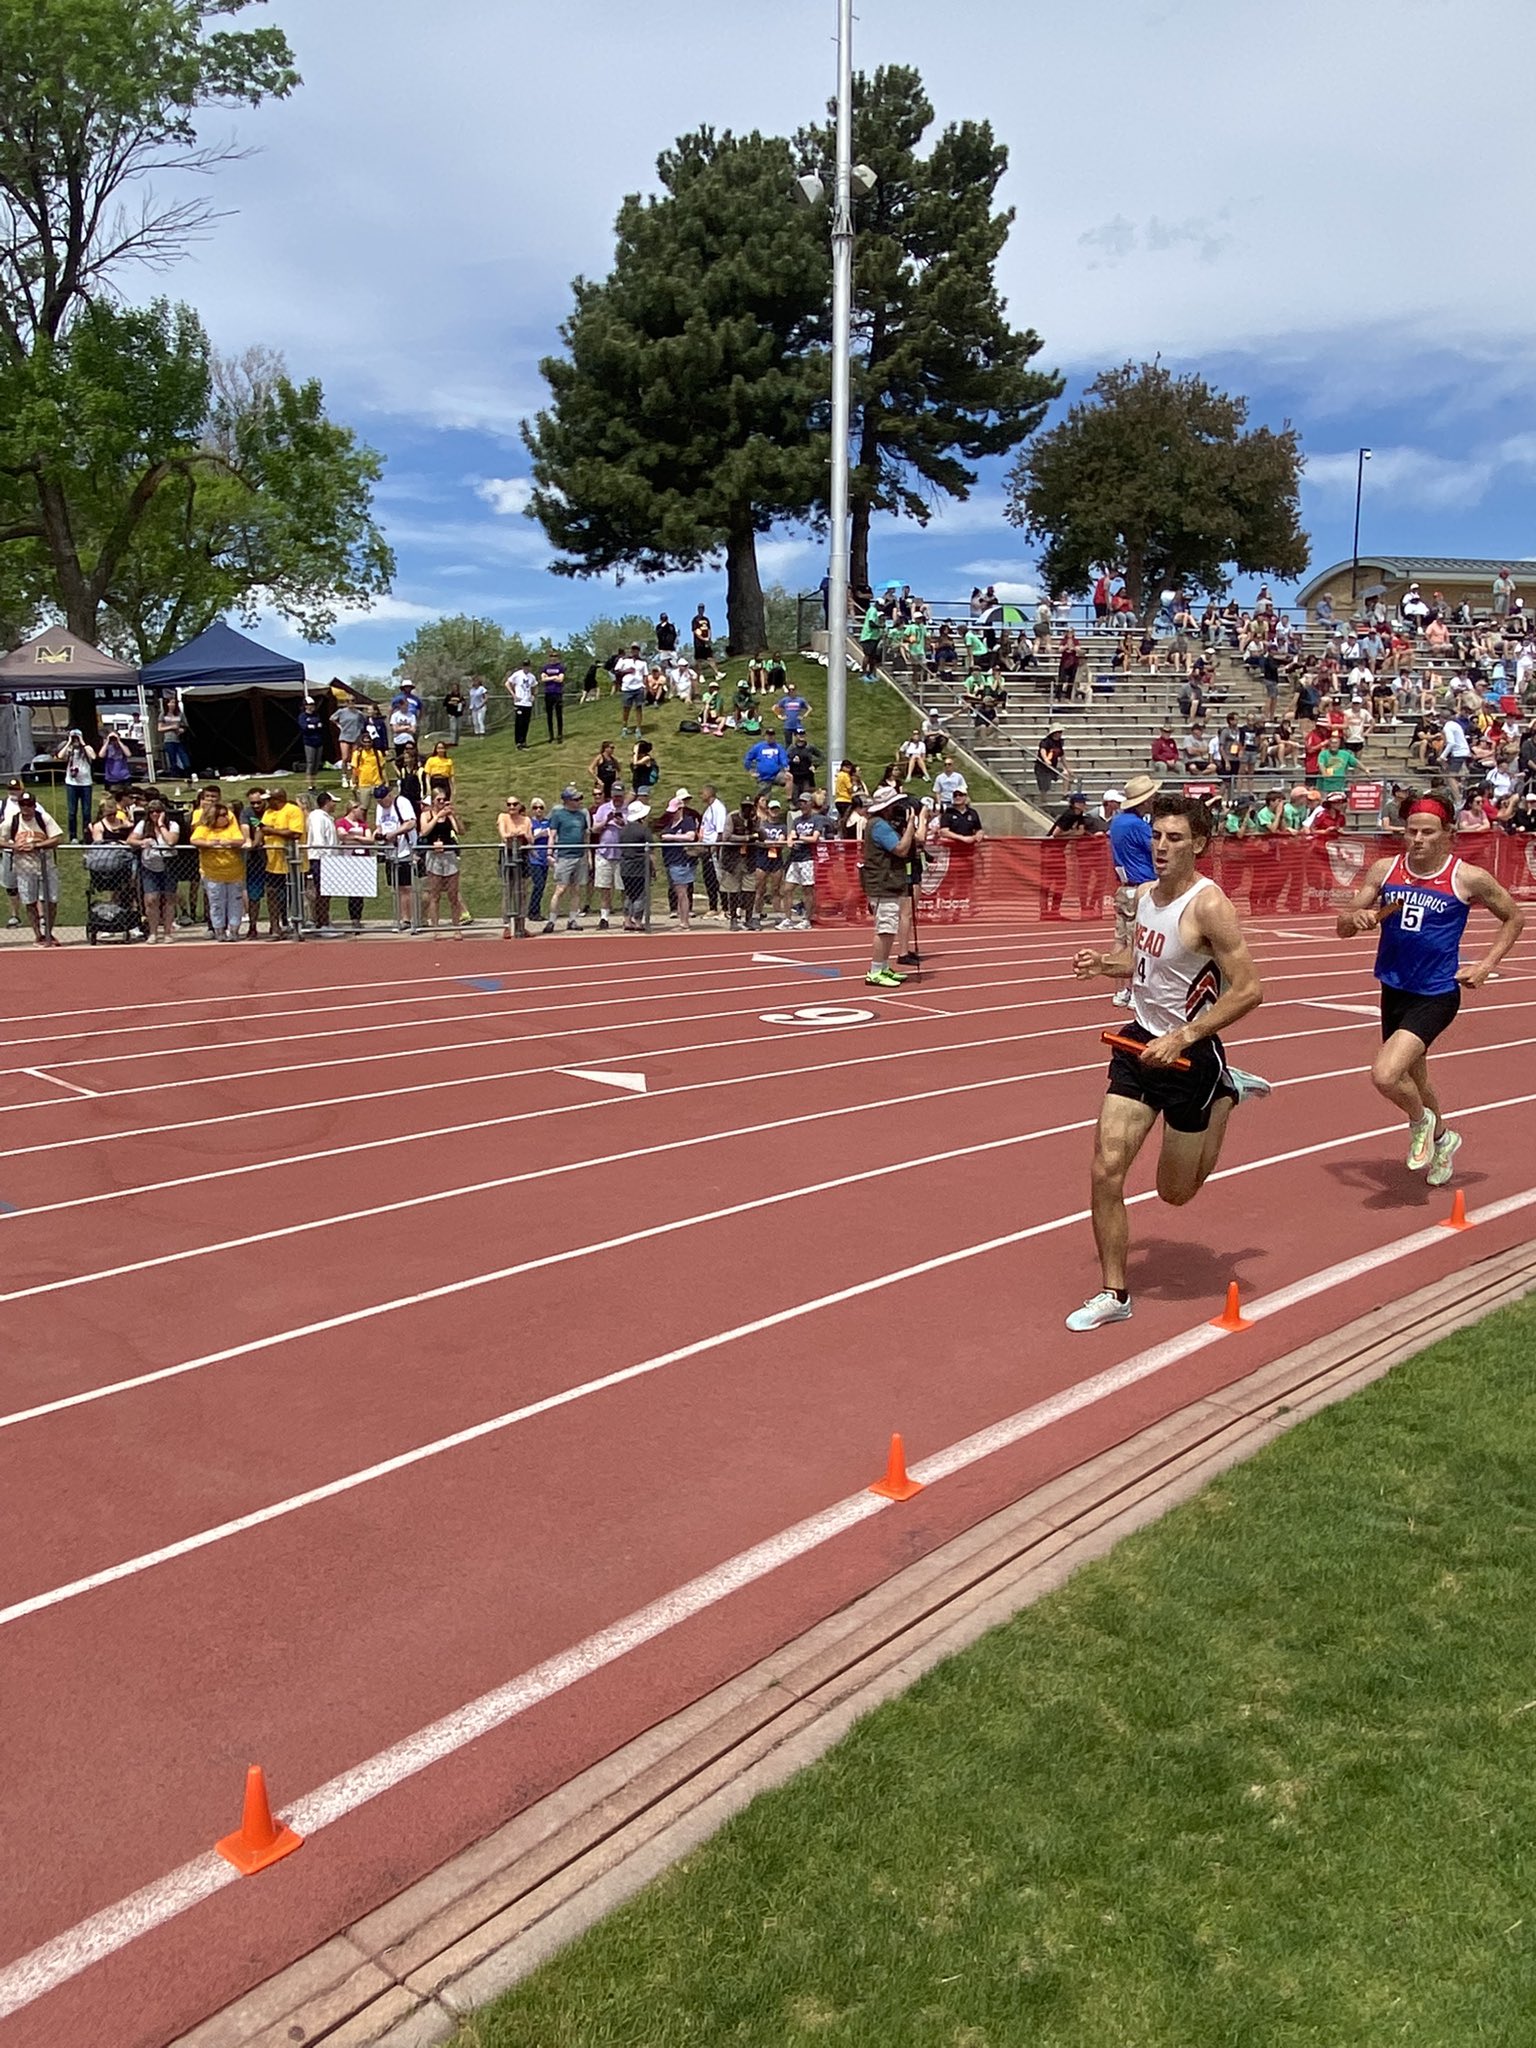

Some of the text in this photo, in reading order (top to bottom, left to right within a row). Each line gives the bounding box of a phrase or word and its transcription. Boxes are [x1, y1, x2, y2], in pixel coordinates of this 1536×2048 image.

[34, 645, 75, 664] M
[1403, 907, 1419, 928] 5
[1137, 957, 1146, 983] 4
